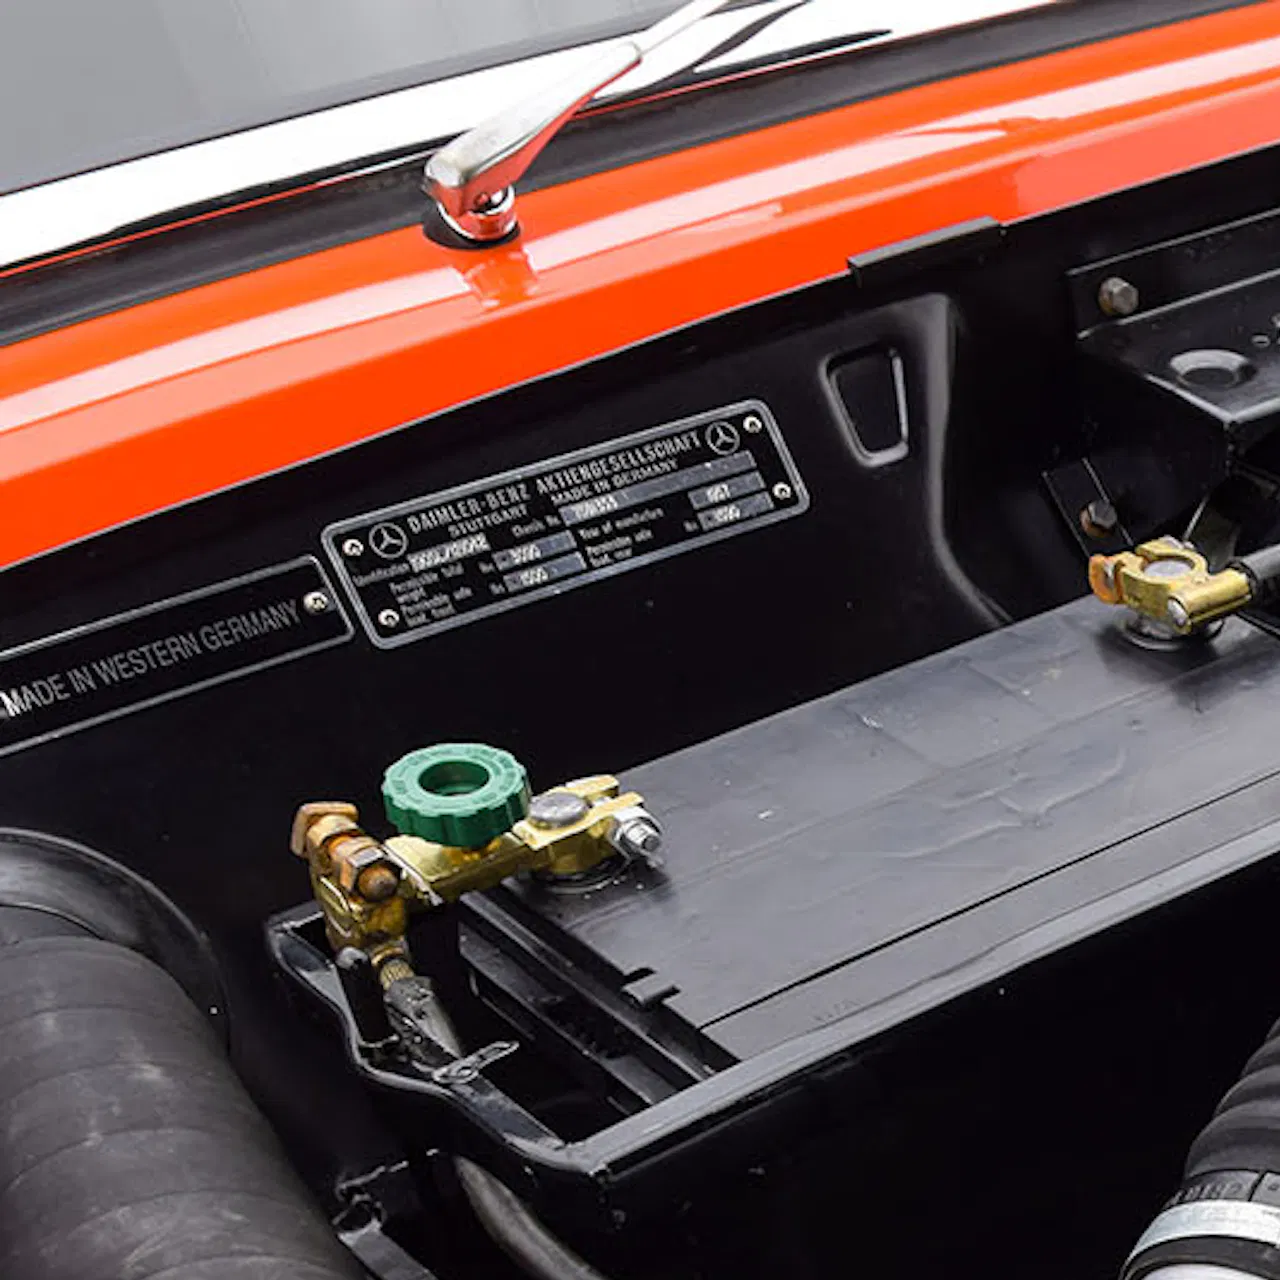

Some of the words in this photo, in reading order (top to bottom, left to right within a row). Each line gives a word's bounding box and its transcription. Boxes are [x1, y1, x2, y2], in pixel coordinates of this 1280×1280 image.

[535, 430, 703, 496] AKTIENGESELLSCHAFT
[551, 486, 593, 505] MADE
[593, 481, 611, 494] IN
[612, 459, 679, 488] GERMANY
[448, 502, 529, 538] STUTTGART
[2, 674, 70, 717] MADE
[67, 670, 97, 693] IN
[92, 632, 203, 686] WESTERN
[200, 600, 302, 652] GERMANY
